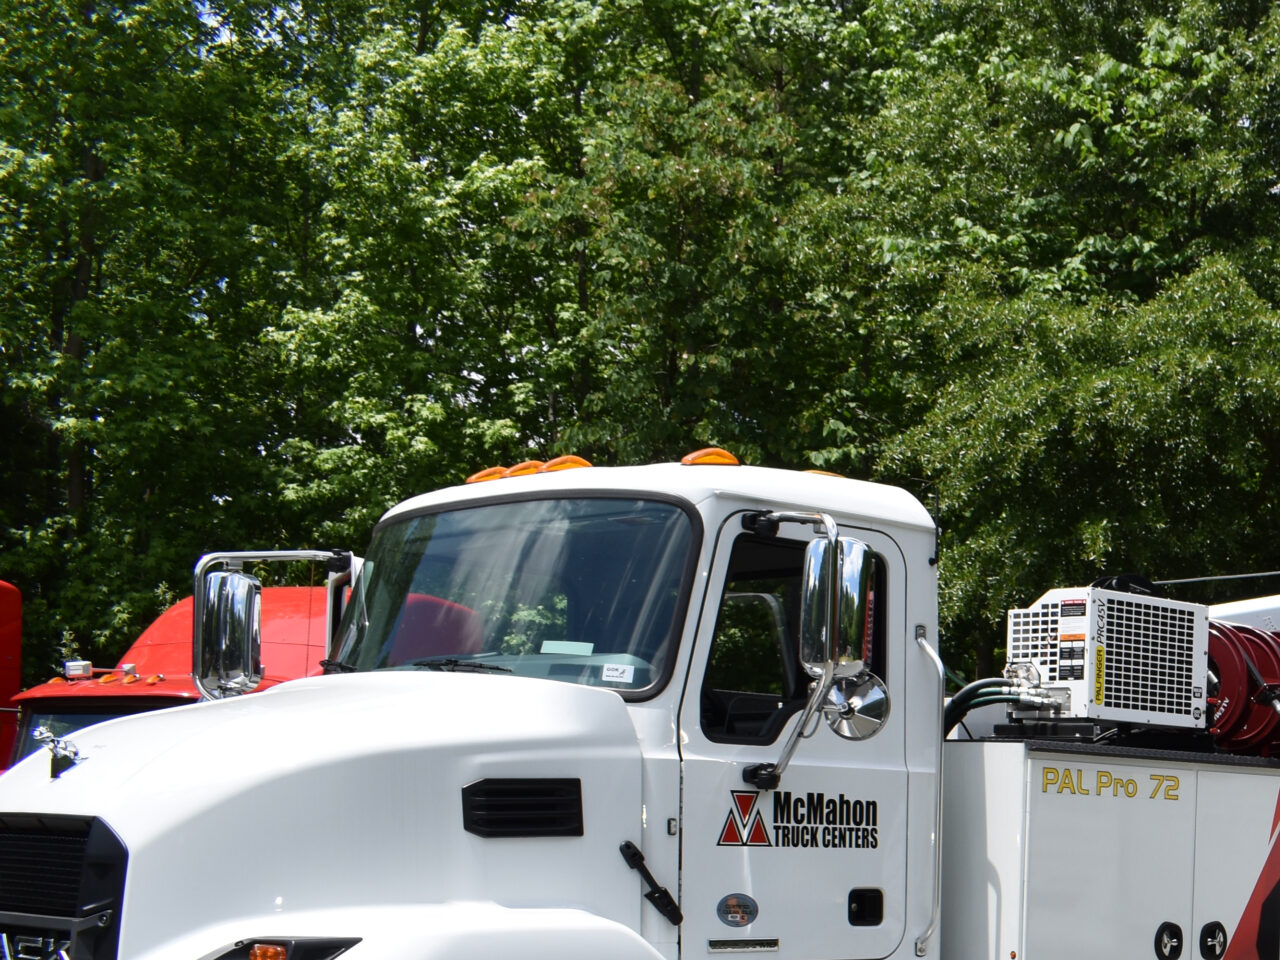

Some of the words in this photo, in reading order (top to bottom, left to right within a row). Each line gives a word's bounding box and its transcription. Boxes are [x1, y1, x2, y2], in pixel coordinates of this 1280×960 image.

[1097, 599, 1106, 645] PRC45V
[1095, 648, 1103, 702] PALFINGER
[1042, 766, 1090, 796] PAL
[1096, 770, 1138, 798] Pro
[1149, 774, 1180, 801] 72
[773, 790, 878, 827] McMahon
[773, 825, 819, 848] TRUCK
[822, 826, 879, 850] CENTERS
